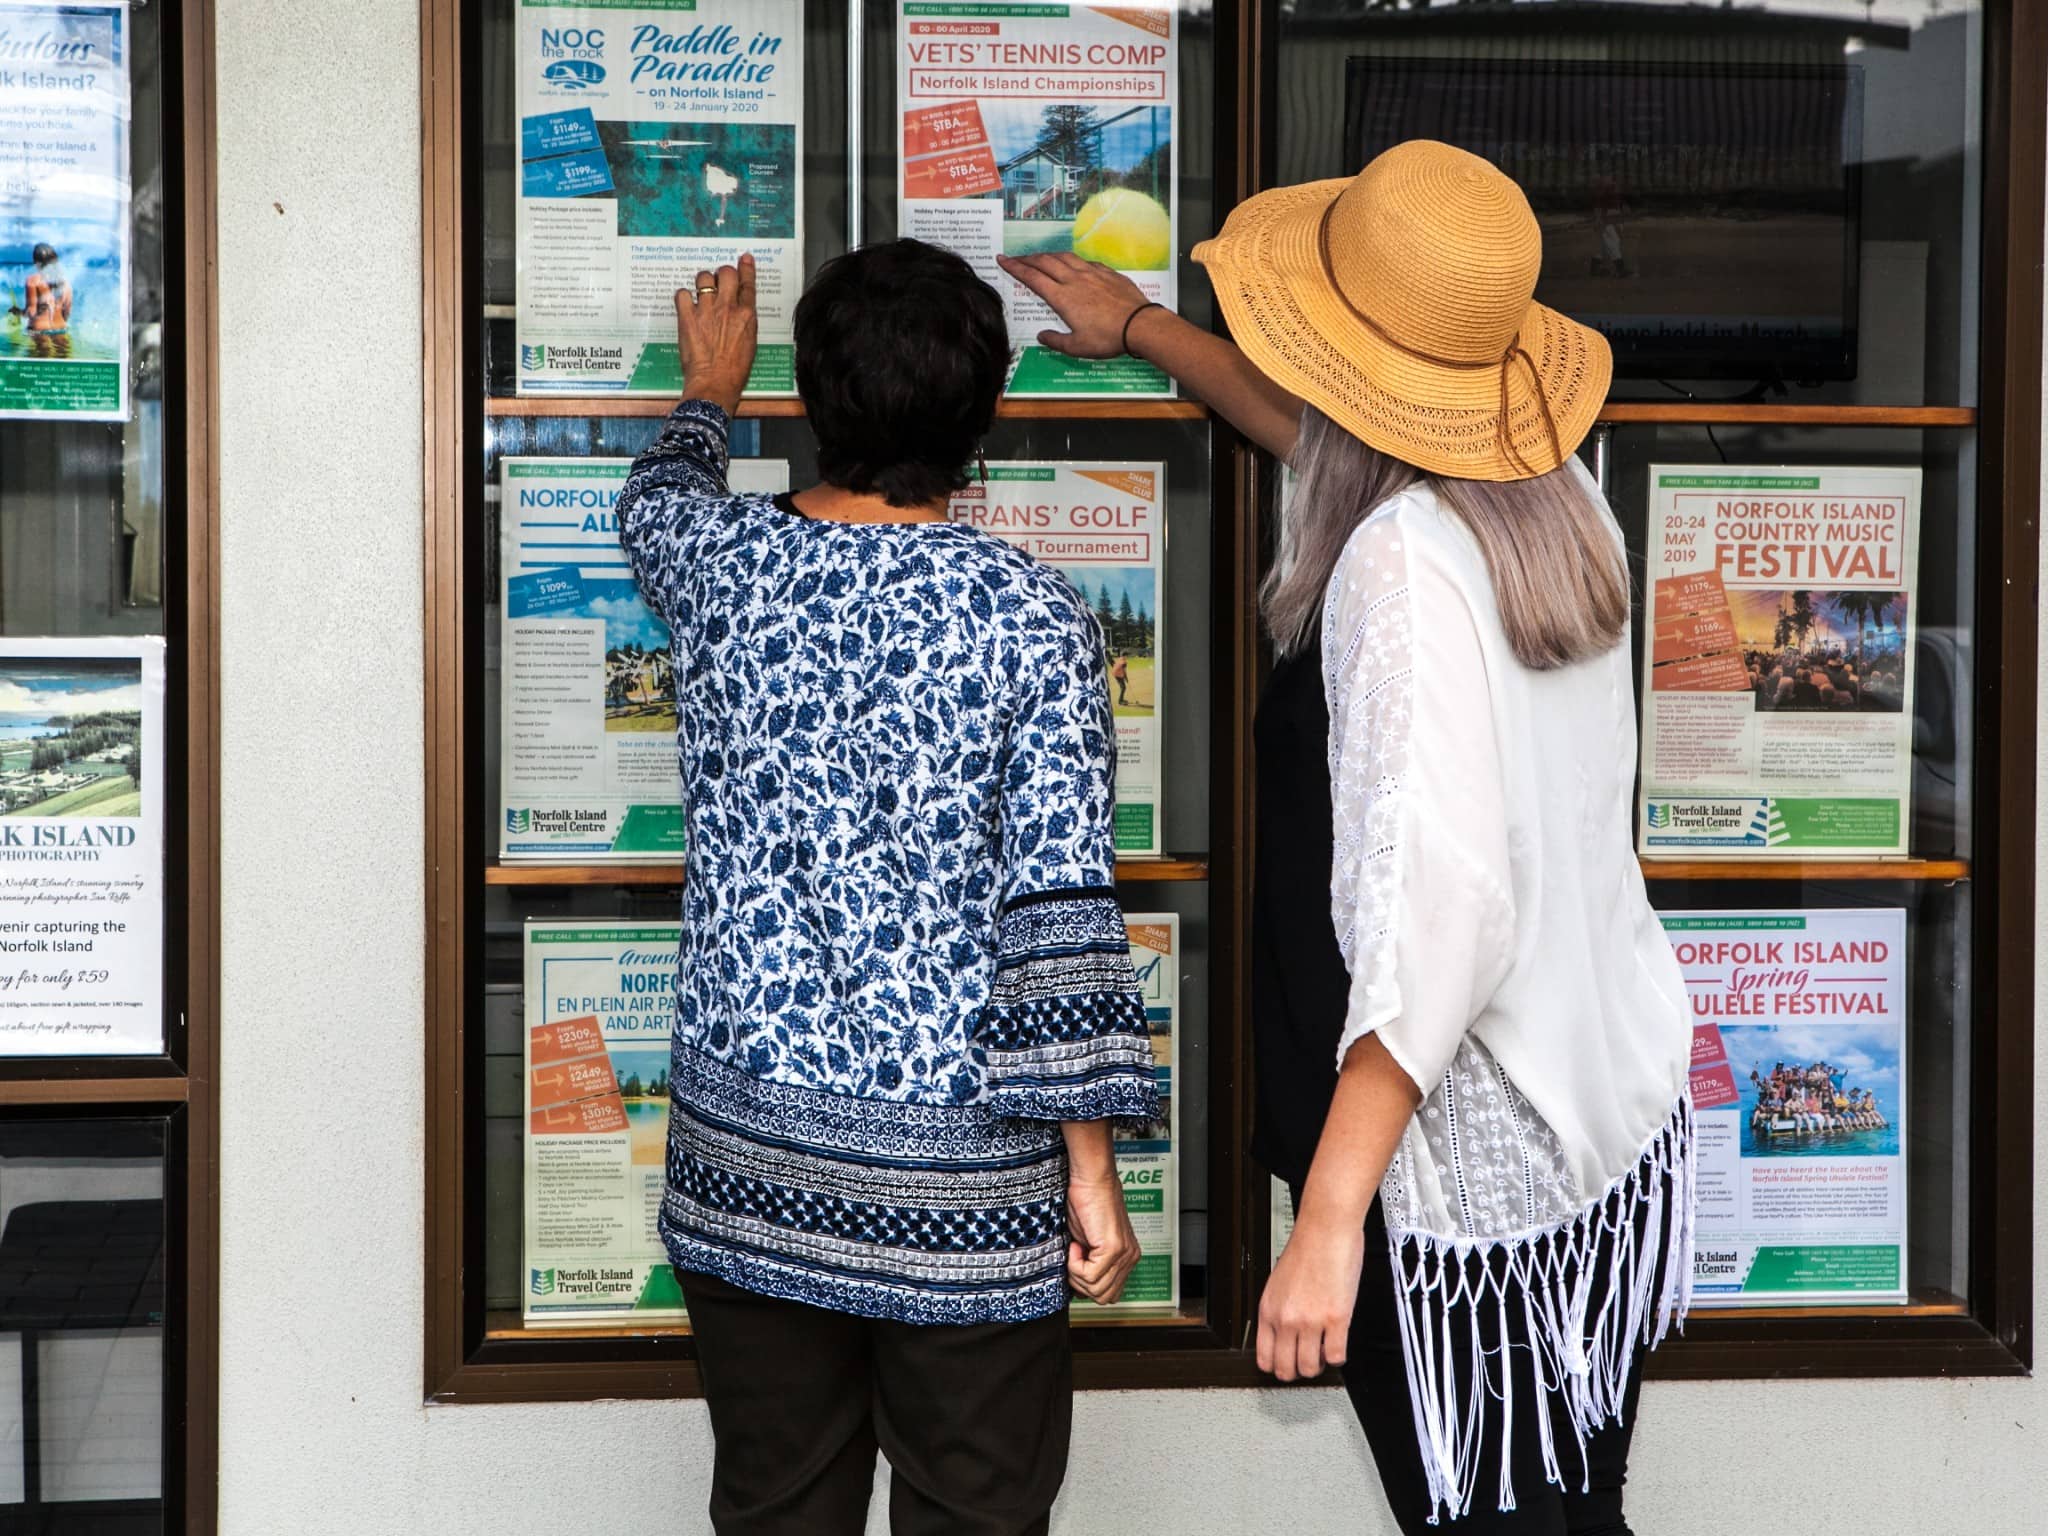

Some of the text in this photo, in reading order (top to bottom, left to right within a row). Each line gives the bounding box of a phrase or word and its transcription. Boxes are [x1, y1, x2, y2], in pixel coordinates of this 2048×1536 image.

[949, 25, 968, 34] April
[970, 25, 991, 33] 2020
[542, 29, 604, 48] NOC
[630, 25, 782, 55] Paddle in
[542, 46, 604, 58] the rock
[908, 43, 1166, 65] VETS' TENNIS COMP
[630, 53, 776, 83] Paradise
[23, 71, 96, 90] Island?
[920, 77, 1155, 92] Norfolk Island Championships
[649, 86, 763, 100] on Norfolk Island
[654, 102, 758, 113] 19 24 January 2020
[553, 122, 579, 135] $1149
[56, 141, 87, 152] Island
[565, 165, 590, 178] $1199
[631, 245, 643, 253] The
[645, 246, 674, 254] Norfolk
[547, 346, 622, 358] Norfolk Island
[547, 358, 621, 370] Travel Centre
[520, 489, 622, 508] NORFOLK
[1069, 505, 1148, 528] GOLF
[1716, 502, 1896, 520] NORFOLK ISLAND
[582, 513, 620, 533] ALL
[1665, 516, 1706, 529] 20-24
[1714, 522, 1894, 542] COUNTRY MUSIC
[1665, 533, 1696, 545] MAY
[1036, 540, 1138, 555] Tournament
[1664, 550, 1696, 562] 2019
[1715, 544, 1896, 579] FESTIVAL
[540, 582, 567, 594] $1099
[1684, 582, 1709, 594] $1179
[1694, 623, 1719, 634] $1169
[532, 810, 607, 821] Norfolk Island
[1672, 805, 1742, 816] Norfolk Island
[532, 822, 606, 832] Travel Centre
[1672, 817, 1740, 827] Travel Centre
[32, 825, 136, 847] ISLAND
[34, 921, 100, 935] capturing
[103, 920, 126, 933] the
[0, 940, 93, 952] Norfolk Island
[1671, 941, 1889, 965] ORFOLK ISLAND
[15, 969, 39, 990] for
[42, 969, 73, 990] only
[1726, 967, 1809, 1001] Spring
[558, 998, 577, 1013] EN
[582, 997, 625, 1013] PLEIN
[629, 997, 653, 1011] AIR
[1688, 992, 1888, 1016] ULELE FESTIVAL
[605, 1015, 672, 1030] AND ART
[558, 1028, 590, 1044] $2309
[570, 1067, 601, 1083] $2449
[581, 1106, 612, 1121] $3019
[1849, 1165, 1873, 1173] about
[1752, 1175, 1779, 1183] Norfolk
[1804, 1175, 1828, 1183] Spring
[1706, 1251, 1738, 1262] Island
[557, 1269, 633, 1280] Norfolk Island
[1702, 1263, 1736, 1274] Centre
[557, 1281, 632, 1293] Travel Centre
